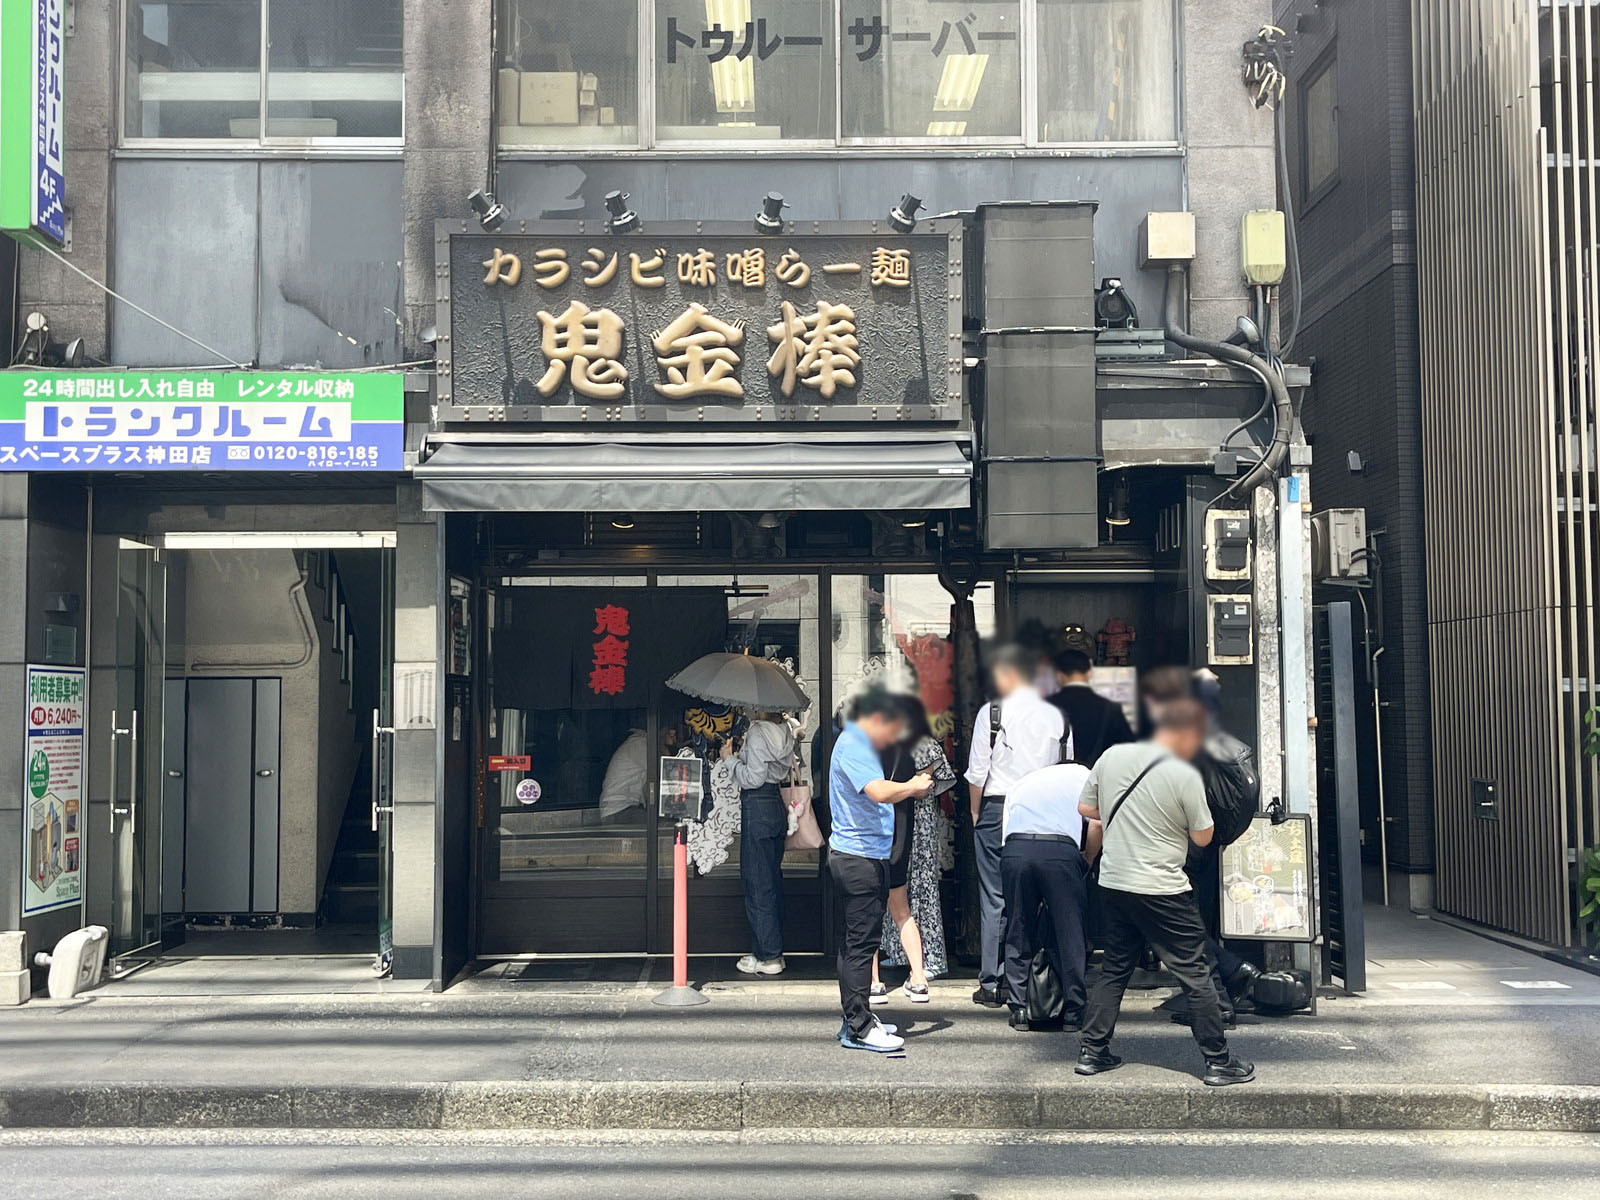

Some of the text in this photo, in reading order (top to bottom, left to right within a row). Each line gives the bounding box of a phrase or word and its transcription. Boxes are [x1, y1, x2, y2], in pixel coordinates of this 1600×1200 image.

[666, 11, 1017, 64] トゥルー サーバー
[40, 168, 57, 200] 4F
[482, 246, 912, 289] カラシビ味噌らー麺
[535, 300, 863, 400] 鬼金棒
[23, 378, 355, 398] 24時間出し入れ自由 レンタル収納
[43, 406, 334, 438] トランクルーム
[0, 445, 212, 465] スペースプラス神田店
[254, 445, 379, 460] 0120-816-185
[308, 460, 378, 468] ハイローイーハコ
[588, 604, 631, 696] 鬼金棒
